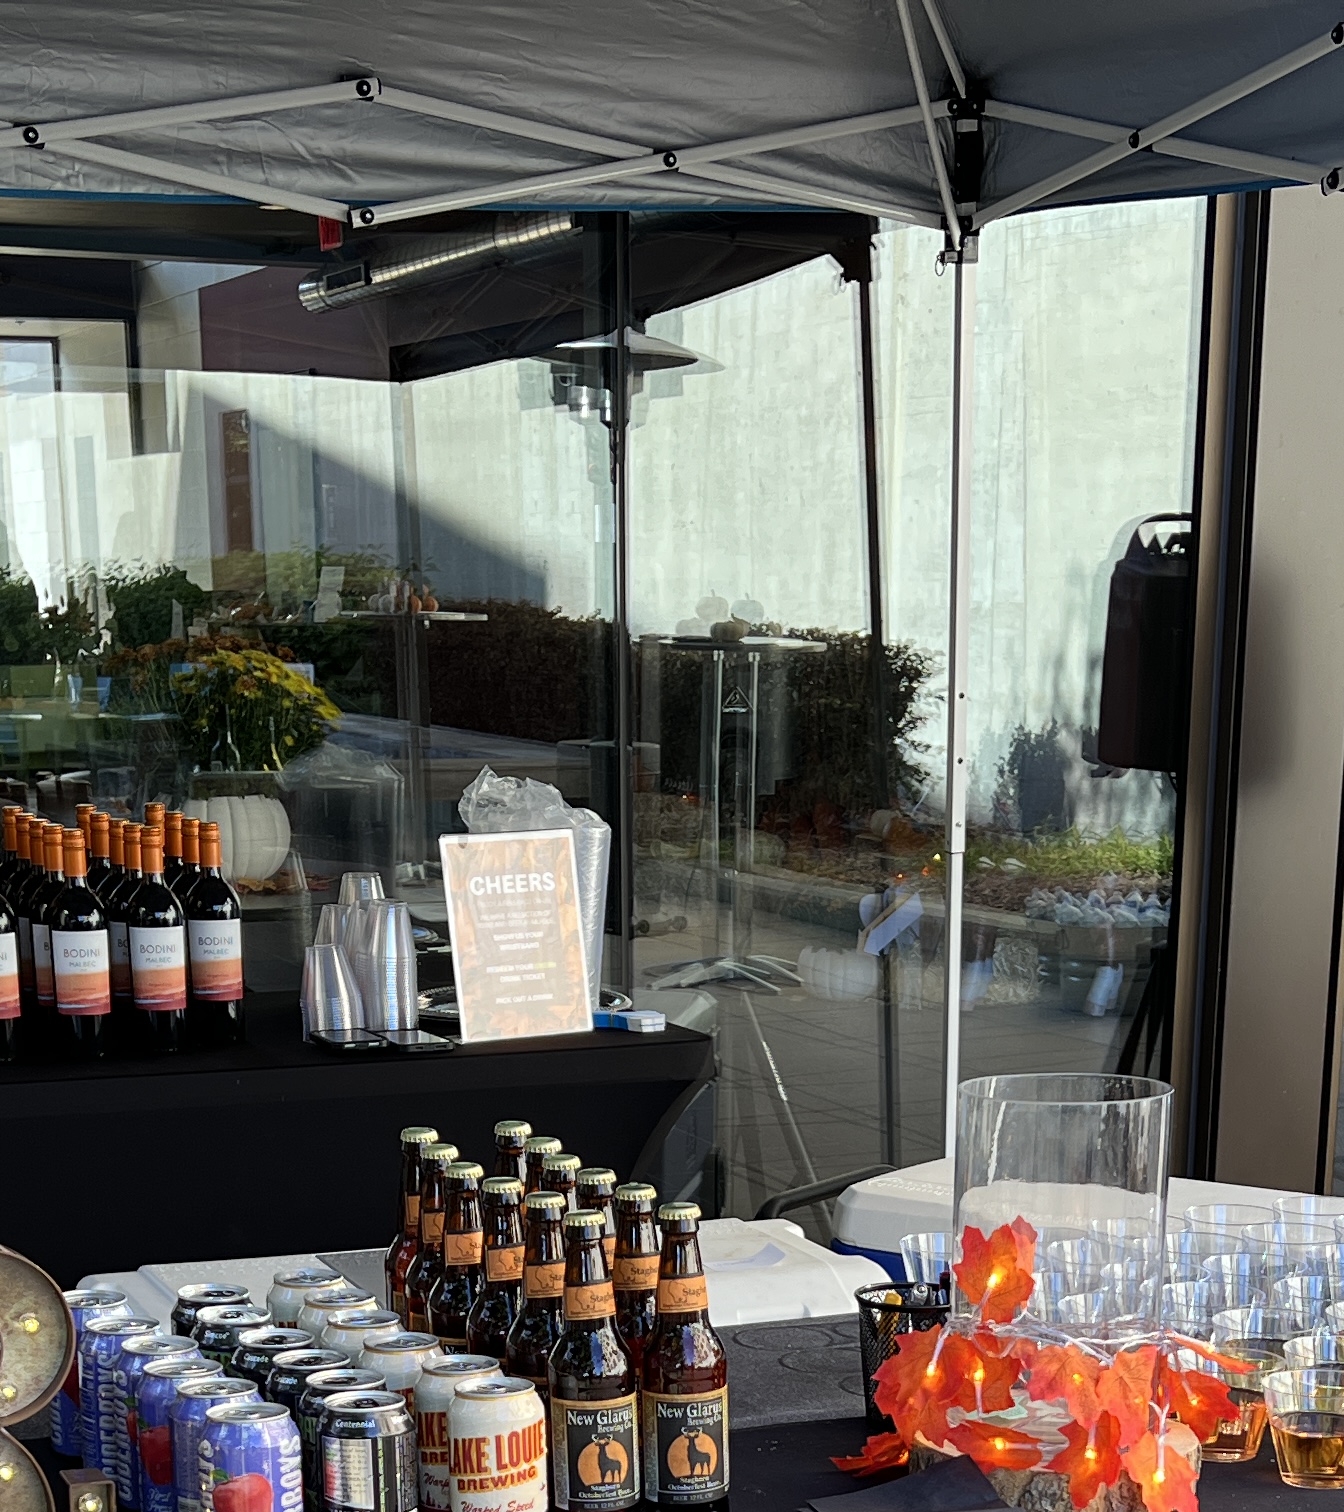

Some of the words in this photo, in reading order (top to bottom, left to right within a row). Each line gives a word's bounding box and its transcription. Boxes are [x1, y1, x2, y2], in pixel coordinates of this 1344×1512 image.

[469, 871, 557, 896] CHEERS
[198, 936, 233, 946] BODINI
[63, 948, 101, 958] BODINI
[139, 944, 176, 954] BODINI
[203, 948, 230, 956] MALBEC
[68, 960, 96, 968] MALBEC
[630, 1262, 658, 1276] Stagh
[657, 1402, 685, 1418] New
[686, 1401, 723, 1418] Glarus
[567, 1410, 595, 1425] New
[597, 1407, 633, 1424] Glarus
[687, 1416, 714, 1426] Brewing
[335, 1418, 376, 1429] Centennial
[597, 1423, 625, 1433] Brewing
[417, 1411, 448, 1449] AKE
[448, 1436, 492, 1476] LAKE
[494, 1417, 547, 1472] LOUIE
[457, 1465, 538, 1494] BREWING
